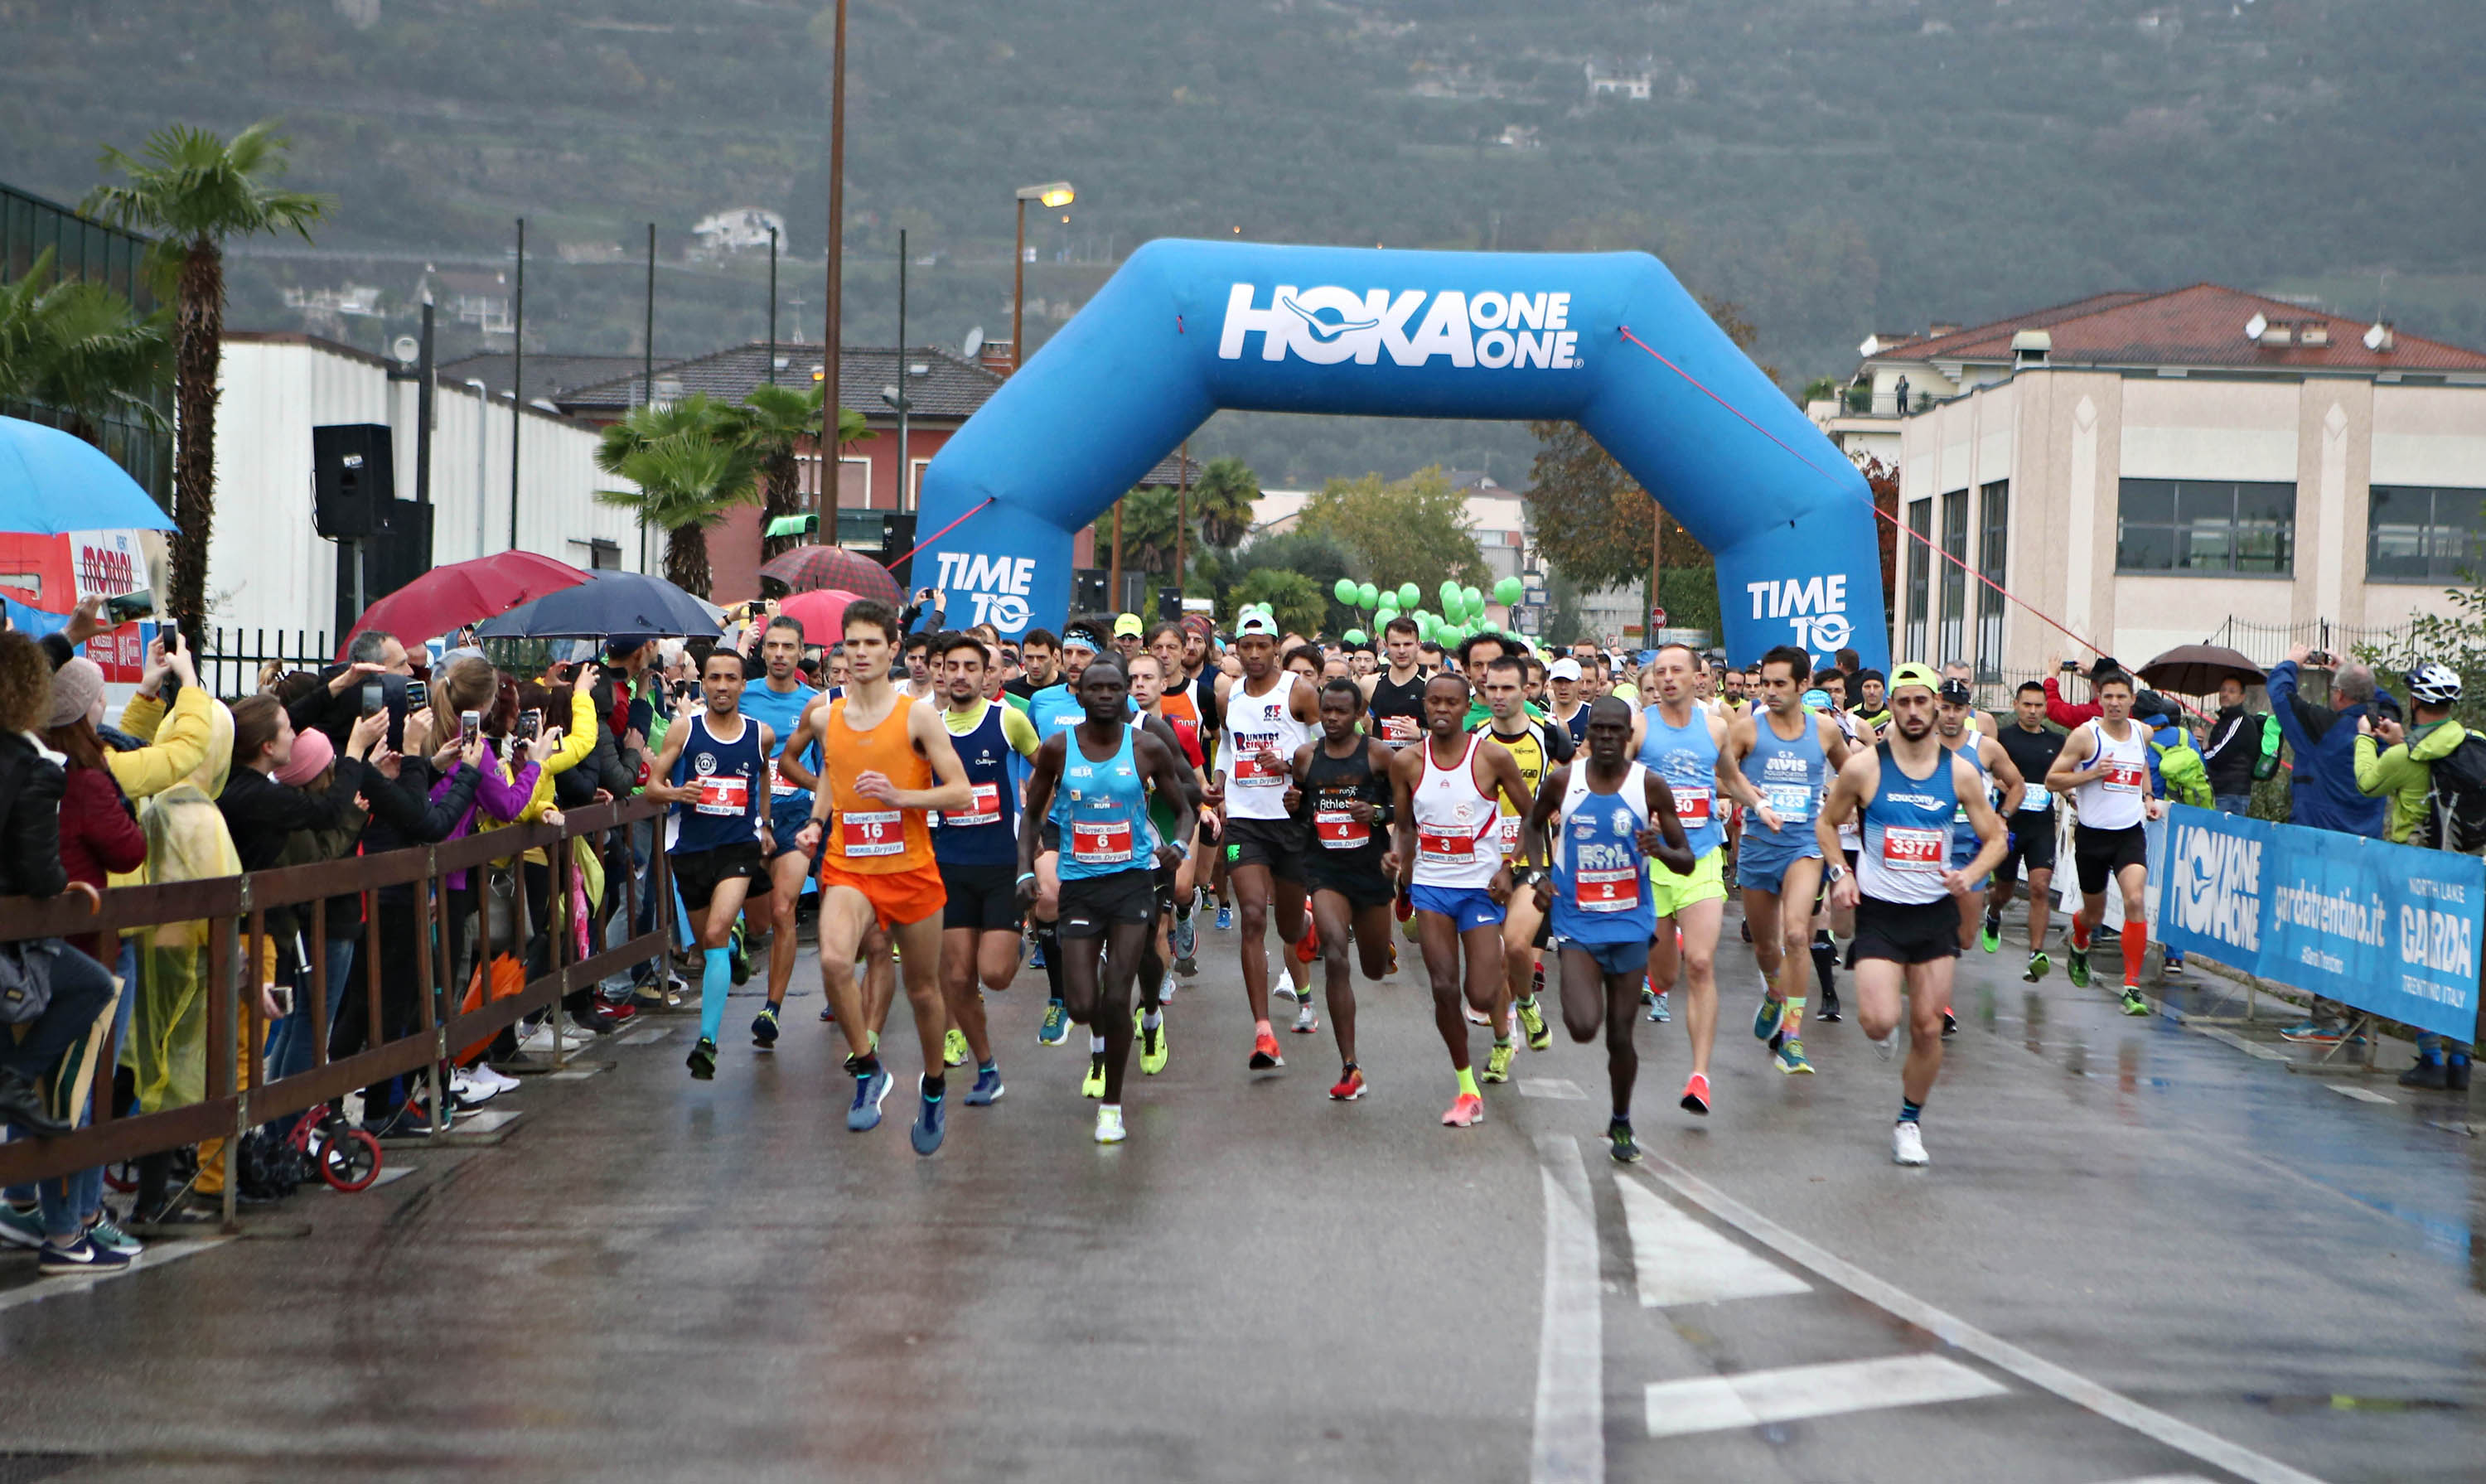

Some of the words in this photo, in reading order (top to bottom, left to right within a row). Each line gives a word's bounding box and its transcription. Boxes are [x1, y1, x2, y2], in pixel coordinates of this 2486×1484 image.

[1219, 283, 1476, 368] HOKA
[1469, 292, 1571, 330] ONE
[1476, 331, 1578, 370] ONE
[937, 552, 1036, 596] TIME
[1747, 573, 1847, 620] TIME
[971, 592, 1030, 634] TO
[1790, 613, 1851, 653] TO
[1766, 757, 1808, 772] AVIS
[2116, 771, 2133, 781] 21
[717, 788, 728, 801] 5
[1886, 792, 1936, 805] saucony
[861, 823, 884, 839] 16
[1097, 834, 1109, 848] 6
[1337, 824, 1348, 837] 4
[1440, 838, 1451, 852] 3
[1890, 839, 1937, 856] 3377
[1602, 883, 1615, 898] 2
[2169, 824, 2233, 945] HOKA
[2232, 837, 2262, 895] ONE
[2409, 877, 2440, 899] NORTH
[2440, 882, 2466, 904] LAKE
[2230, 892, 2261, 953] ONE
[2273, 877, 2387, 948] gardatrentino.it
[2401, 903, 2473, 979] GARDA
[2401, 974, 2441, 1003] TRENTINO
[2441, 984, 2467, 1008] ITALY
